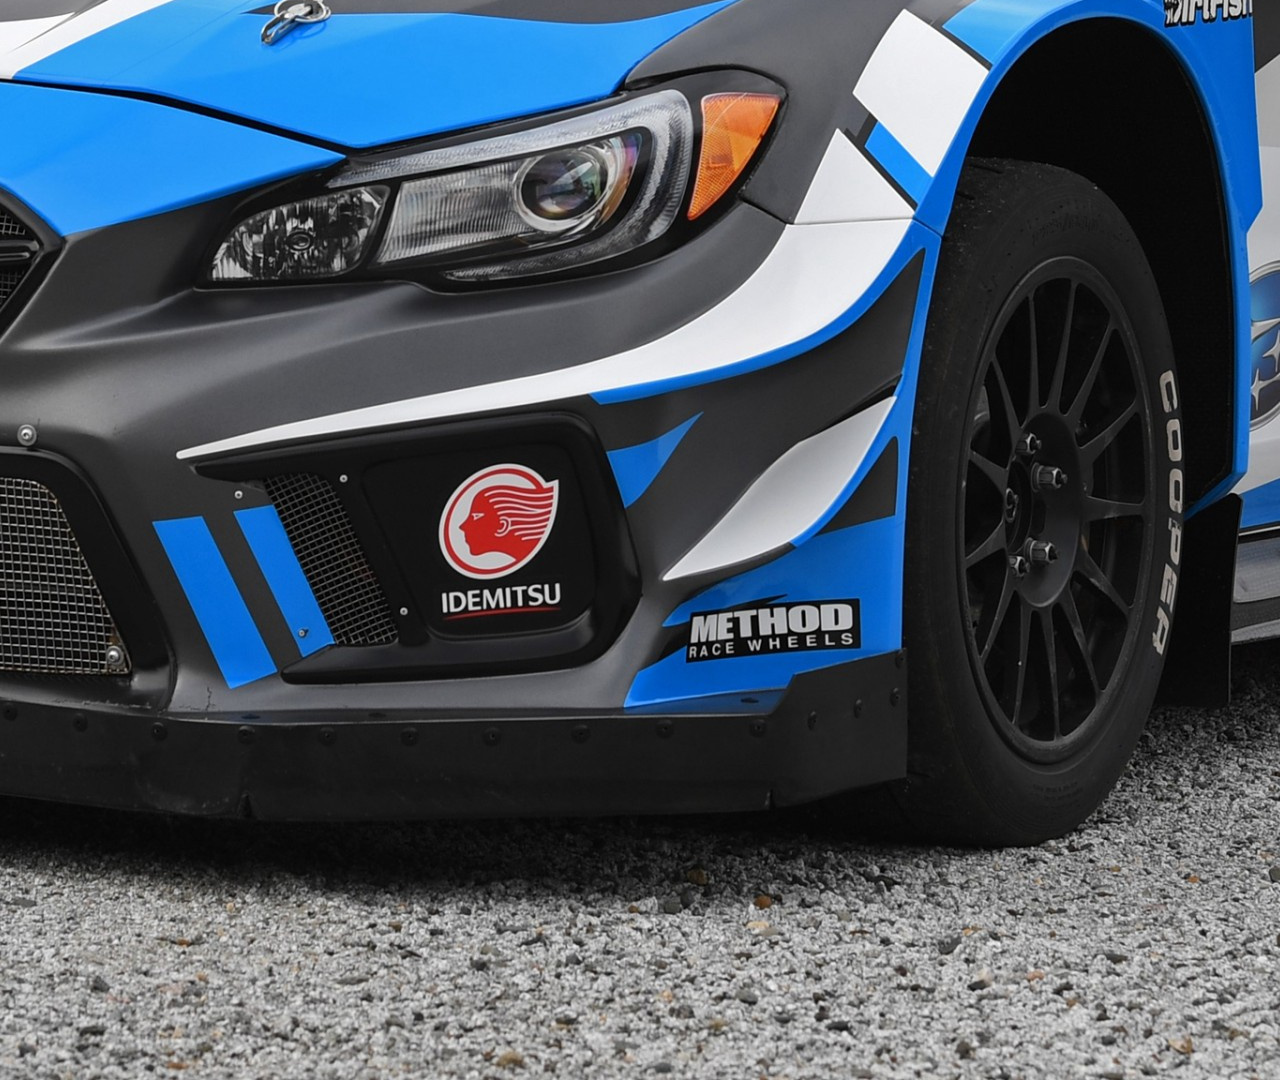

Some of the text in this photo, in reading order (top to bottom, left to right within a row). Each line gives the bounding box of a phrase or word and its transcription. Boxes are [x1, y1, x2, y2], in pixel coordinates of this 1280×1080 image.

[1153, 369, 1185, 656] COOPER
[441, 582, 561, 614] IDEMITSU
[691, 603, 855, 642] METHOD
[689, 632, 855, 660] RACE WHEELS
